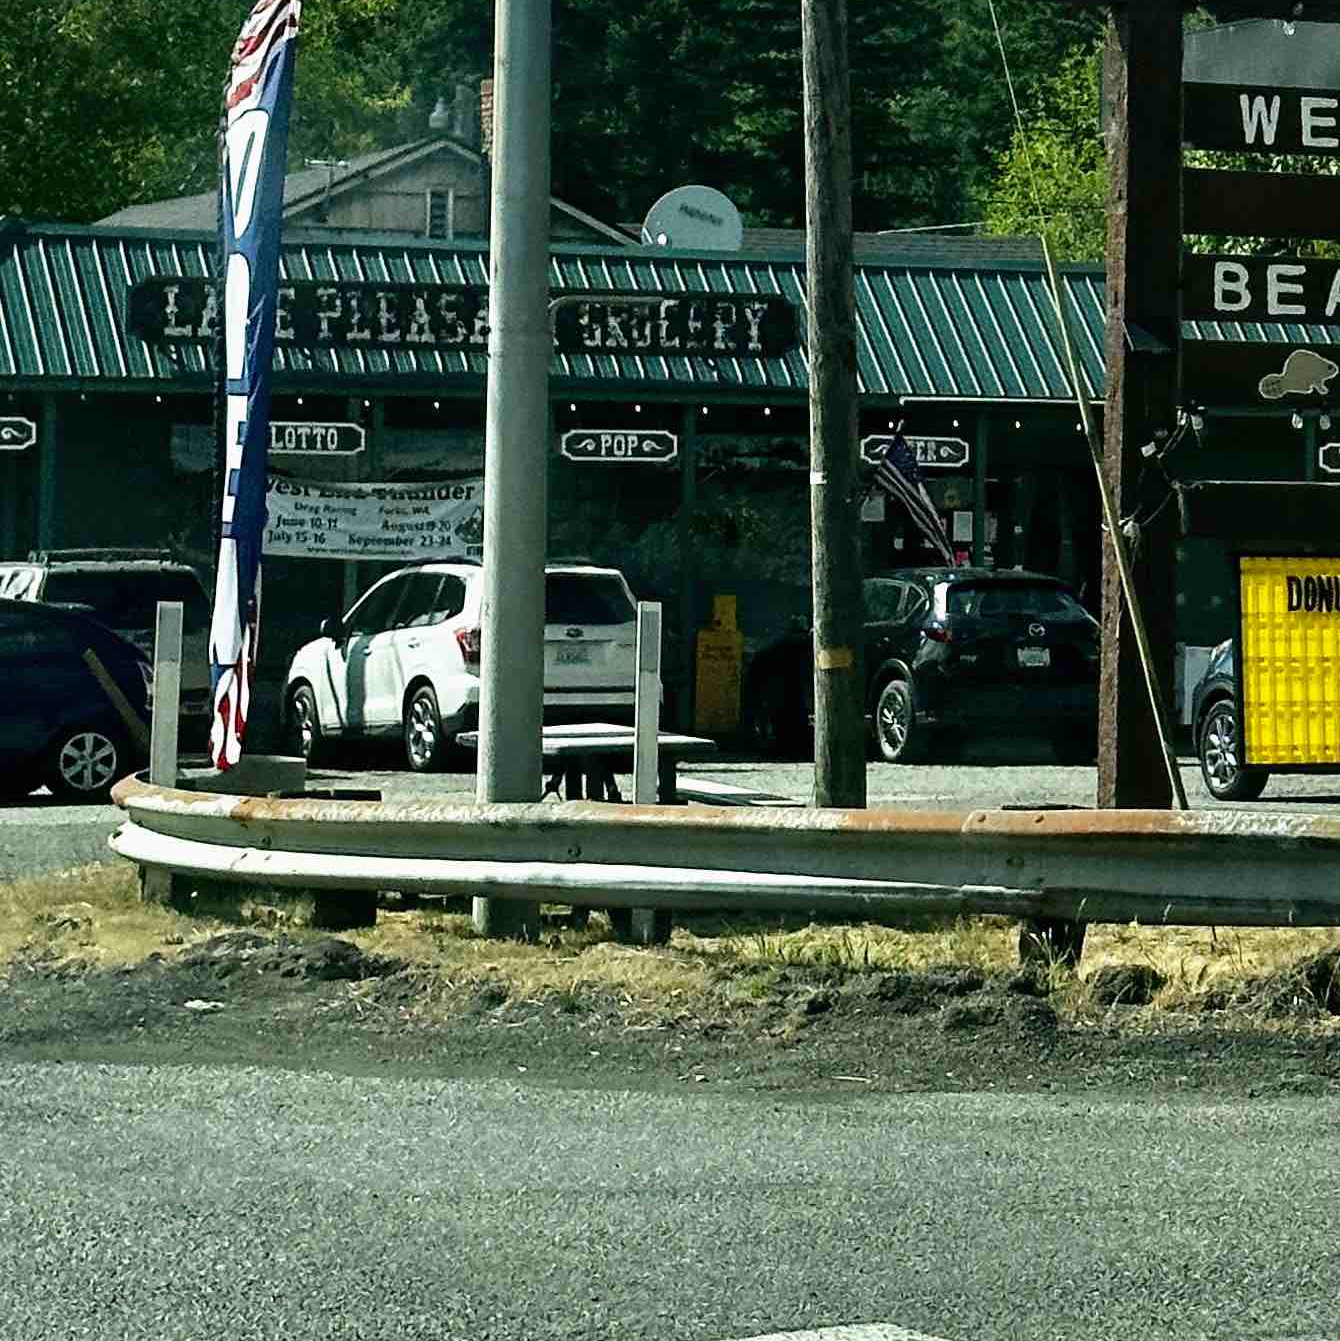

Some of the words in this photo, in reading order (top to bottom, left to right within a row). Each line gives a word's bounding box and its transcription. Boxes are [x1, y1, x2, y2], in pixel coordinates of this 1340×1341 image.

[163, 284, 297, 340] LAE
[271, 427, 339, 451] LOTTO
[600, 434, 639, 457] POP
[267, 530, 291, 545] July
